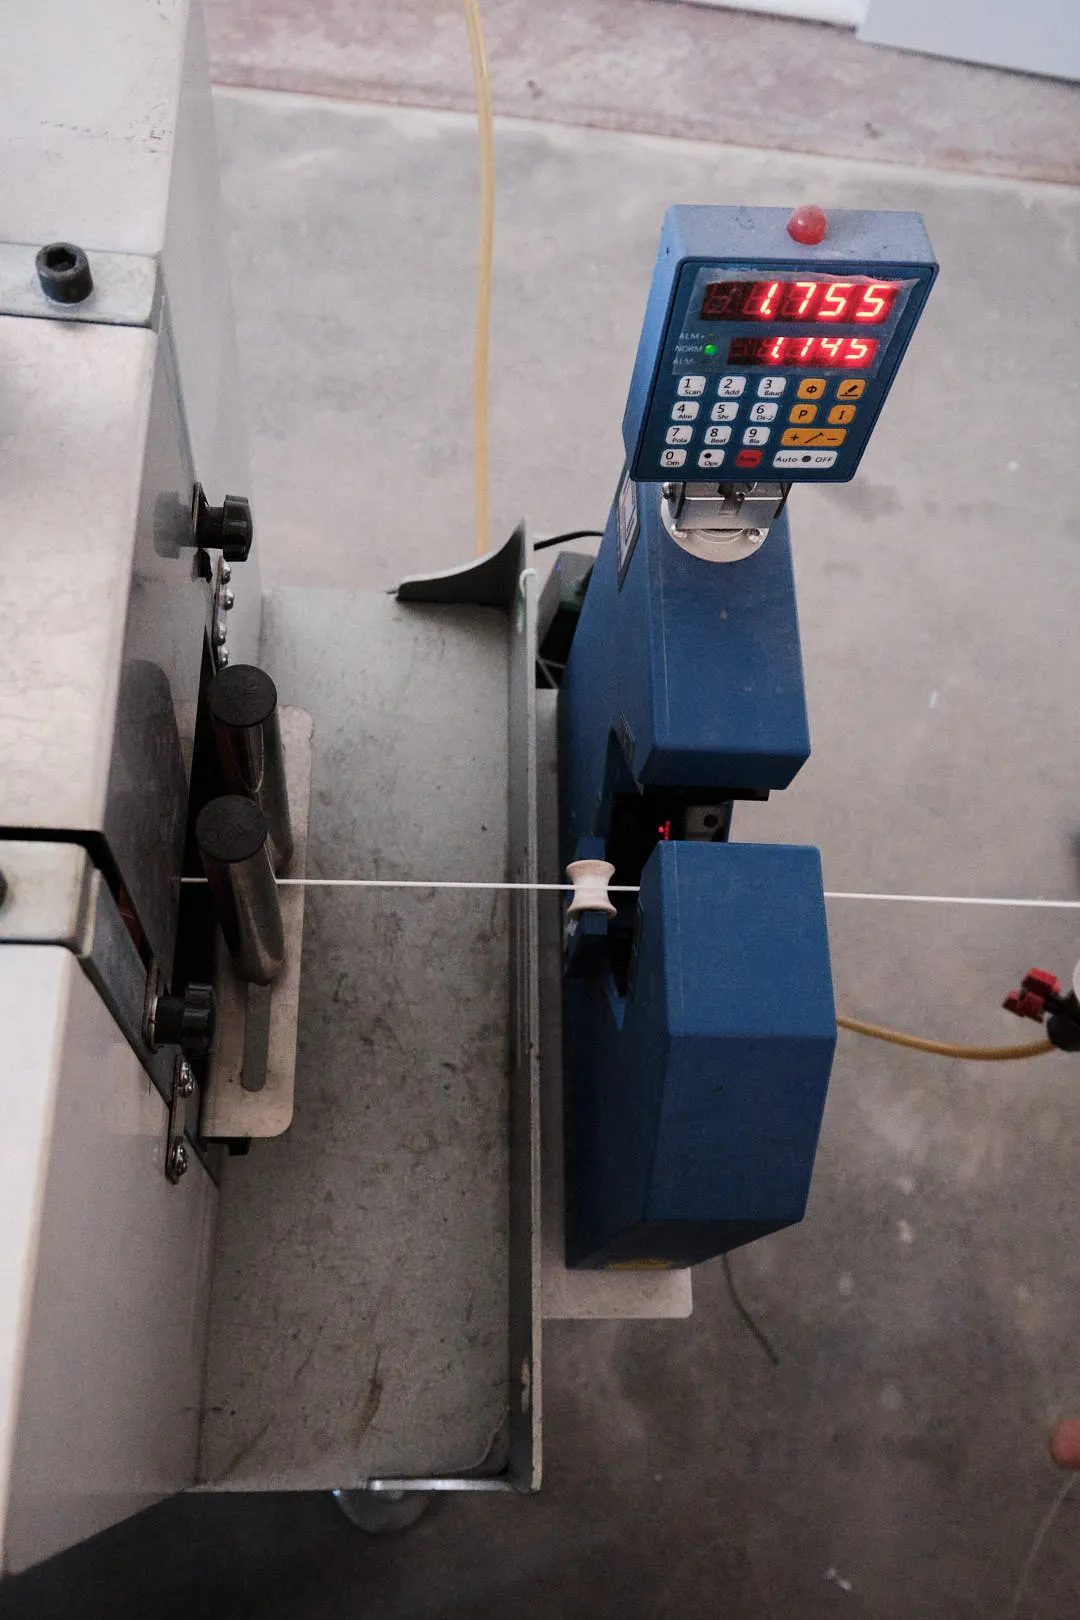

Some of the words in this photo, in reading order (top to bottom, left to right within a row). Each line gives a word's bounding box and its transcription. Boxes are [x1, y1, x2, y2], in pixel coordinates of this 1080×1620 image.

[760, 281, 890, 317] 1.755
[770, 337, 868, 359] 1.145
[684, 378, 691, 388] 1
[724, 378, 733, 389] 2
[764, 379, 772, 389] 3
[677, 403, 685, 413] 4
[717, 404, 725, 413] 5
[756, 404, 765, 414] 6
[798, 410, 808, 419] P
[672, 427, 680, 437] 7
[710, 428, 718, 437] 8
[749, 428, 757, 438] 9
